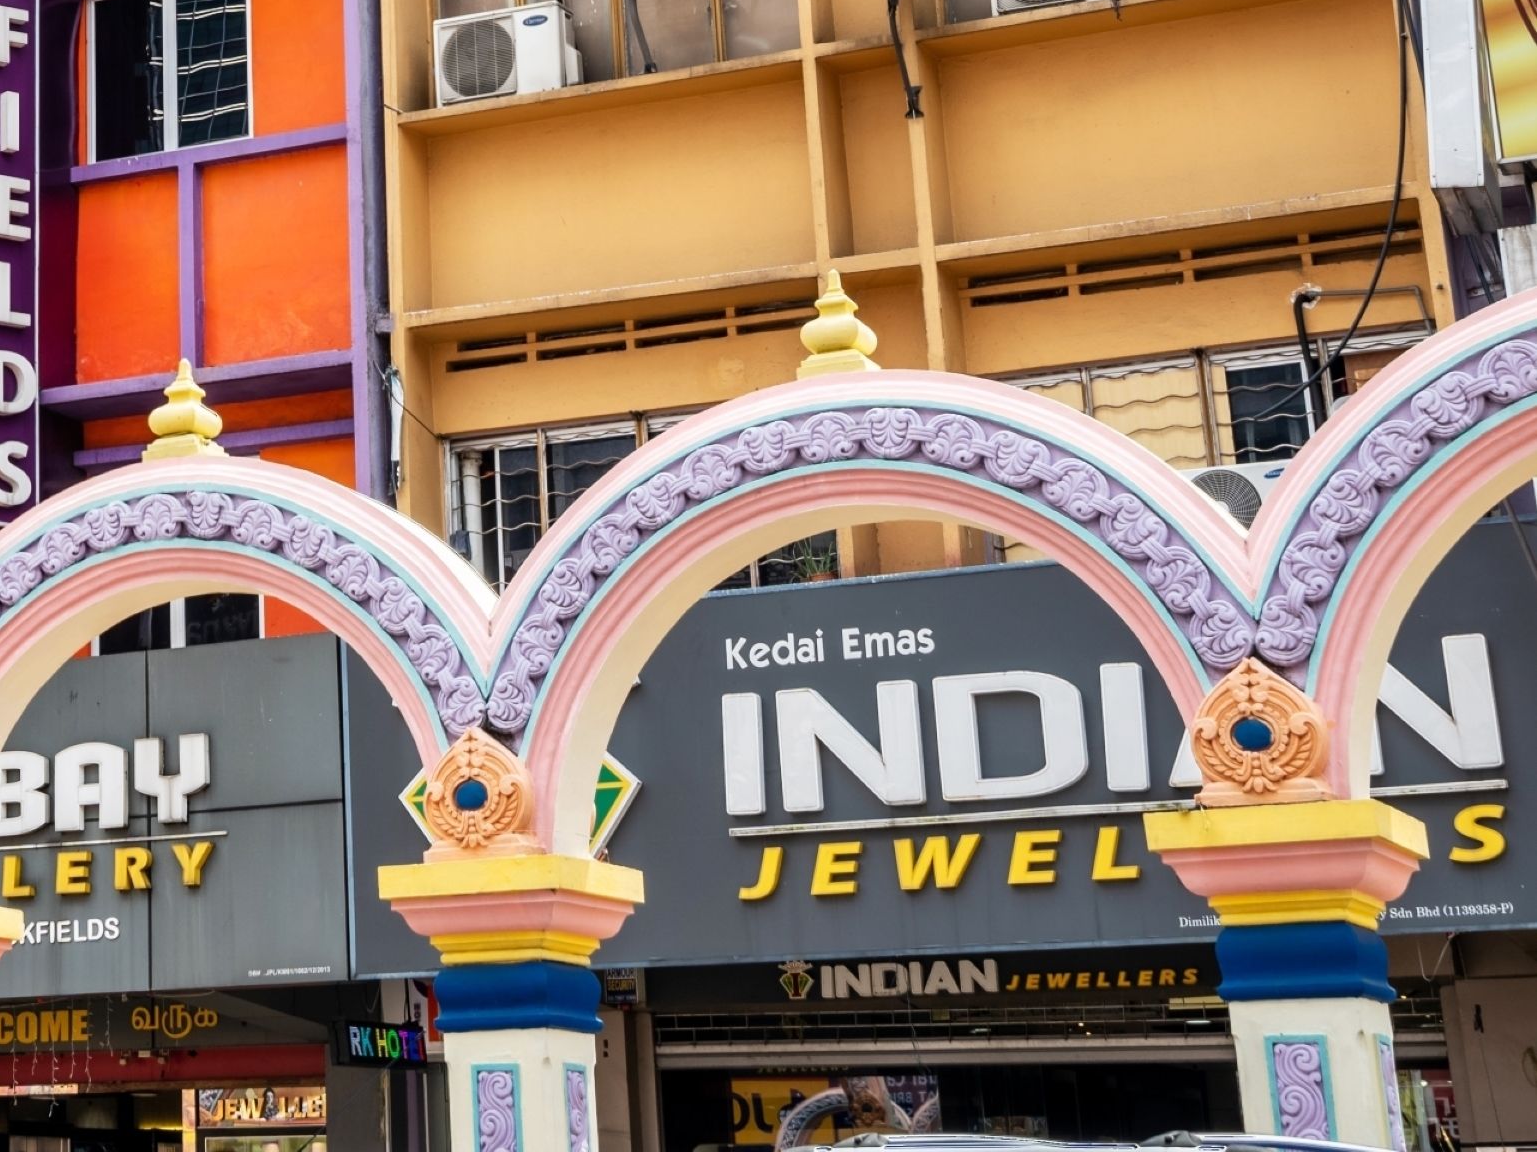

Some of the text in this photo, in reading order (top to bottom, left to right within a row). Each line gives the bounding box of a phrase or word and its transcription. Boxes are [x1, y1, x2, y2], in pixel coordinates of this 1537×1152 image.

[725, 627, 936, 670] Kedai Emas
[721, 632, 1506, 816] INDIN
[738, 803, 1508, 901] JEWELS
[1389, 904, 1414, 919] Sdn
[1416, 903, 1441, 918] Bhd
[12, 916, 120, 945] KFIELDS
[820, 958, 1199, 999] INDIAN JEWELLERS
[131, 1003, 219, 1039] வருக
[349, 1026, 374, 1057] RK
